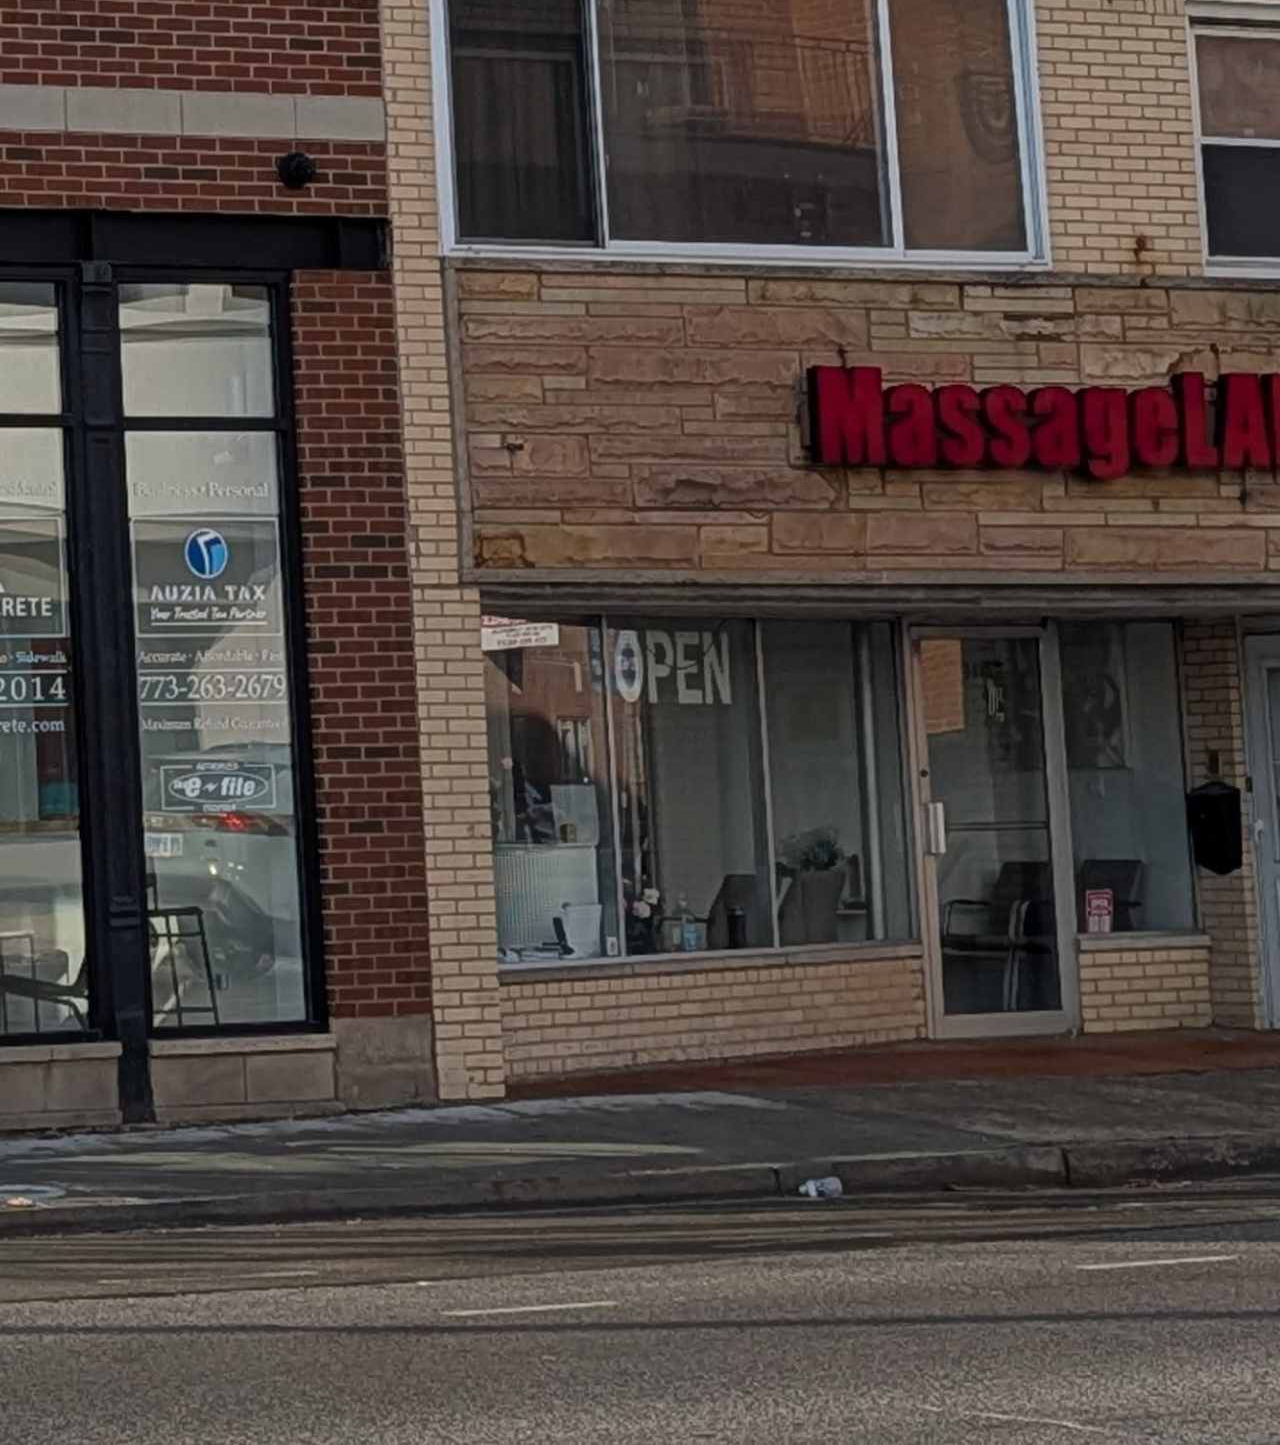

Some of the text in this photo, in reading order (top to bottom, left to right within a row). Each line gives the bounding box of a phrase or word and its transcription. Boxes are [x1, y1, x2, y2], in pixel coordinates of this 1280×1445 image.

[209, 481, 269, 498] Personal
[151, 585, 266, 601] AUZIA TAX
[16, 651, 67, 664] Sidewalk
[614, 629, 732, 704] OPEN
[140, 674, 286, 700] 773-263-2679
